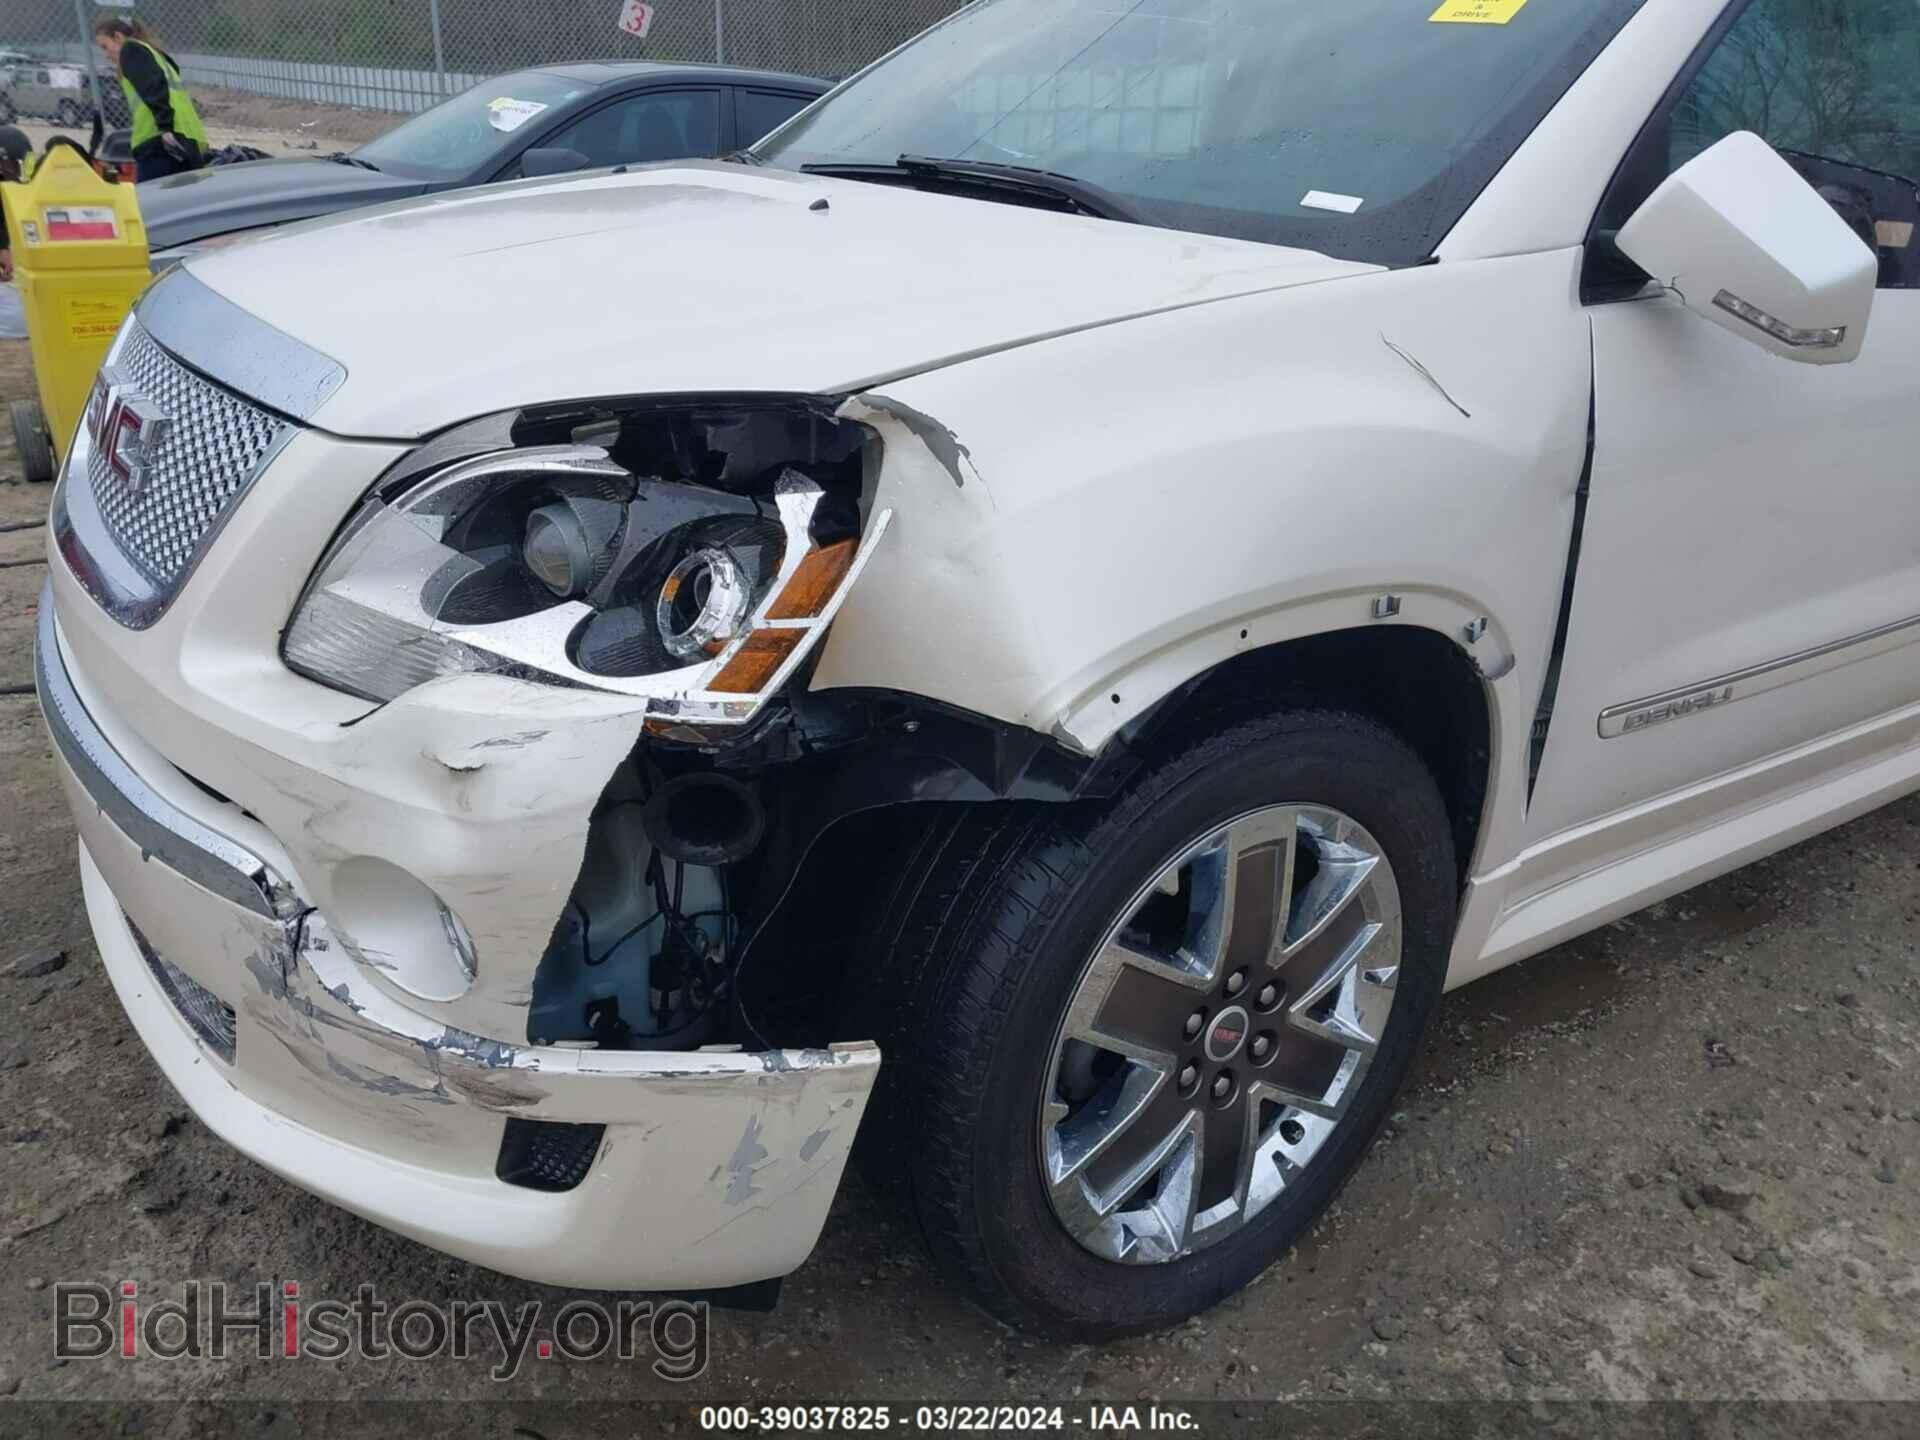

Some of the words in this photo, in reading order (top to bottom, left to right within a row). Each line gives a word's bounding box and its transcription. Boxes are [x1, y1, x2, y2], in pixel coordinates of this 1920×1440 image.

[626, 3, 646, 33] 3
[1451, 9, 1493, 18] DRIVE
[1622, 687, 1734, 731] DENALI
